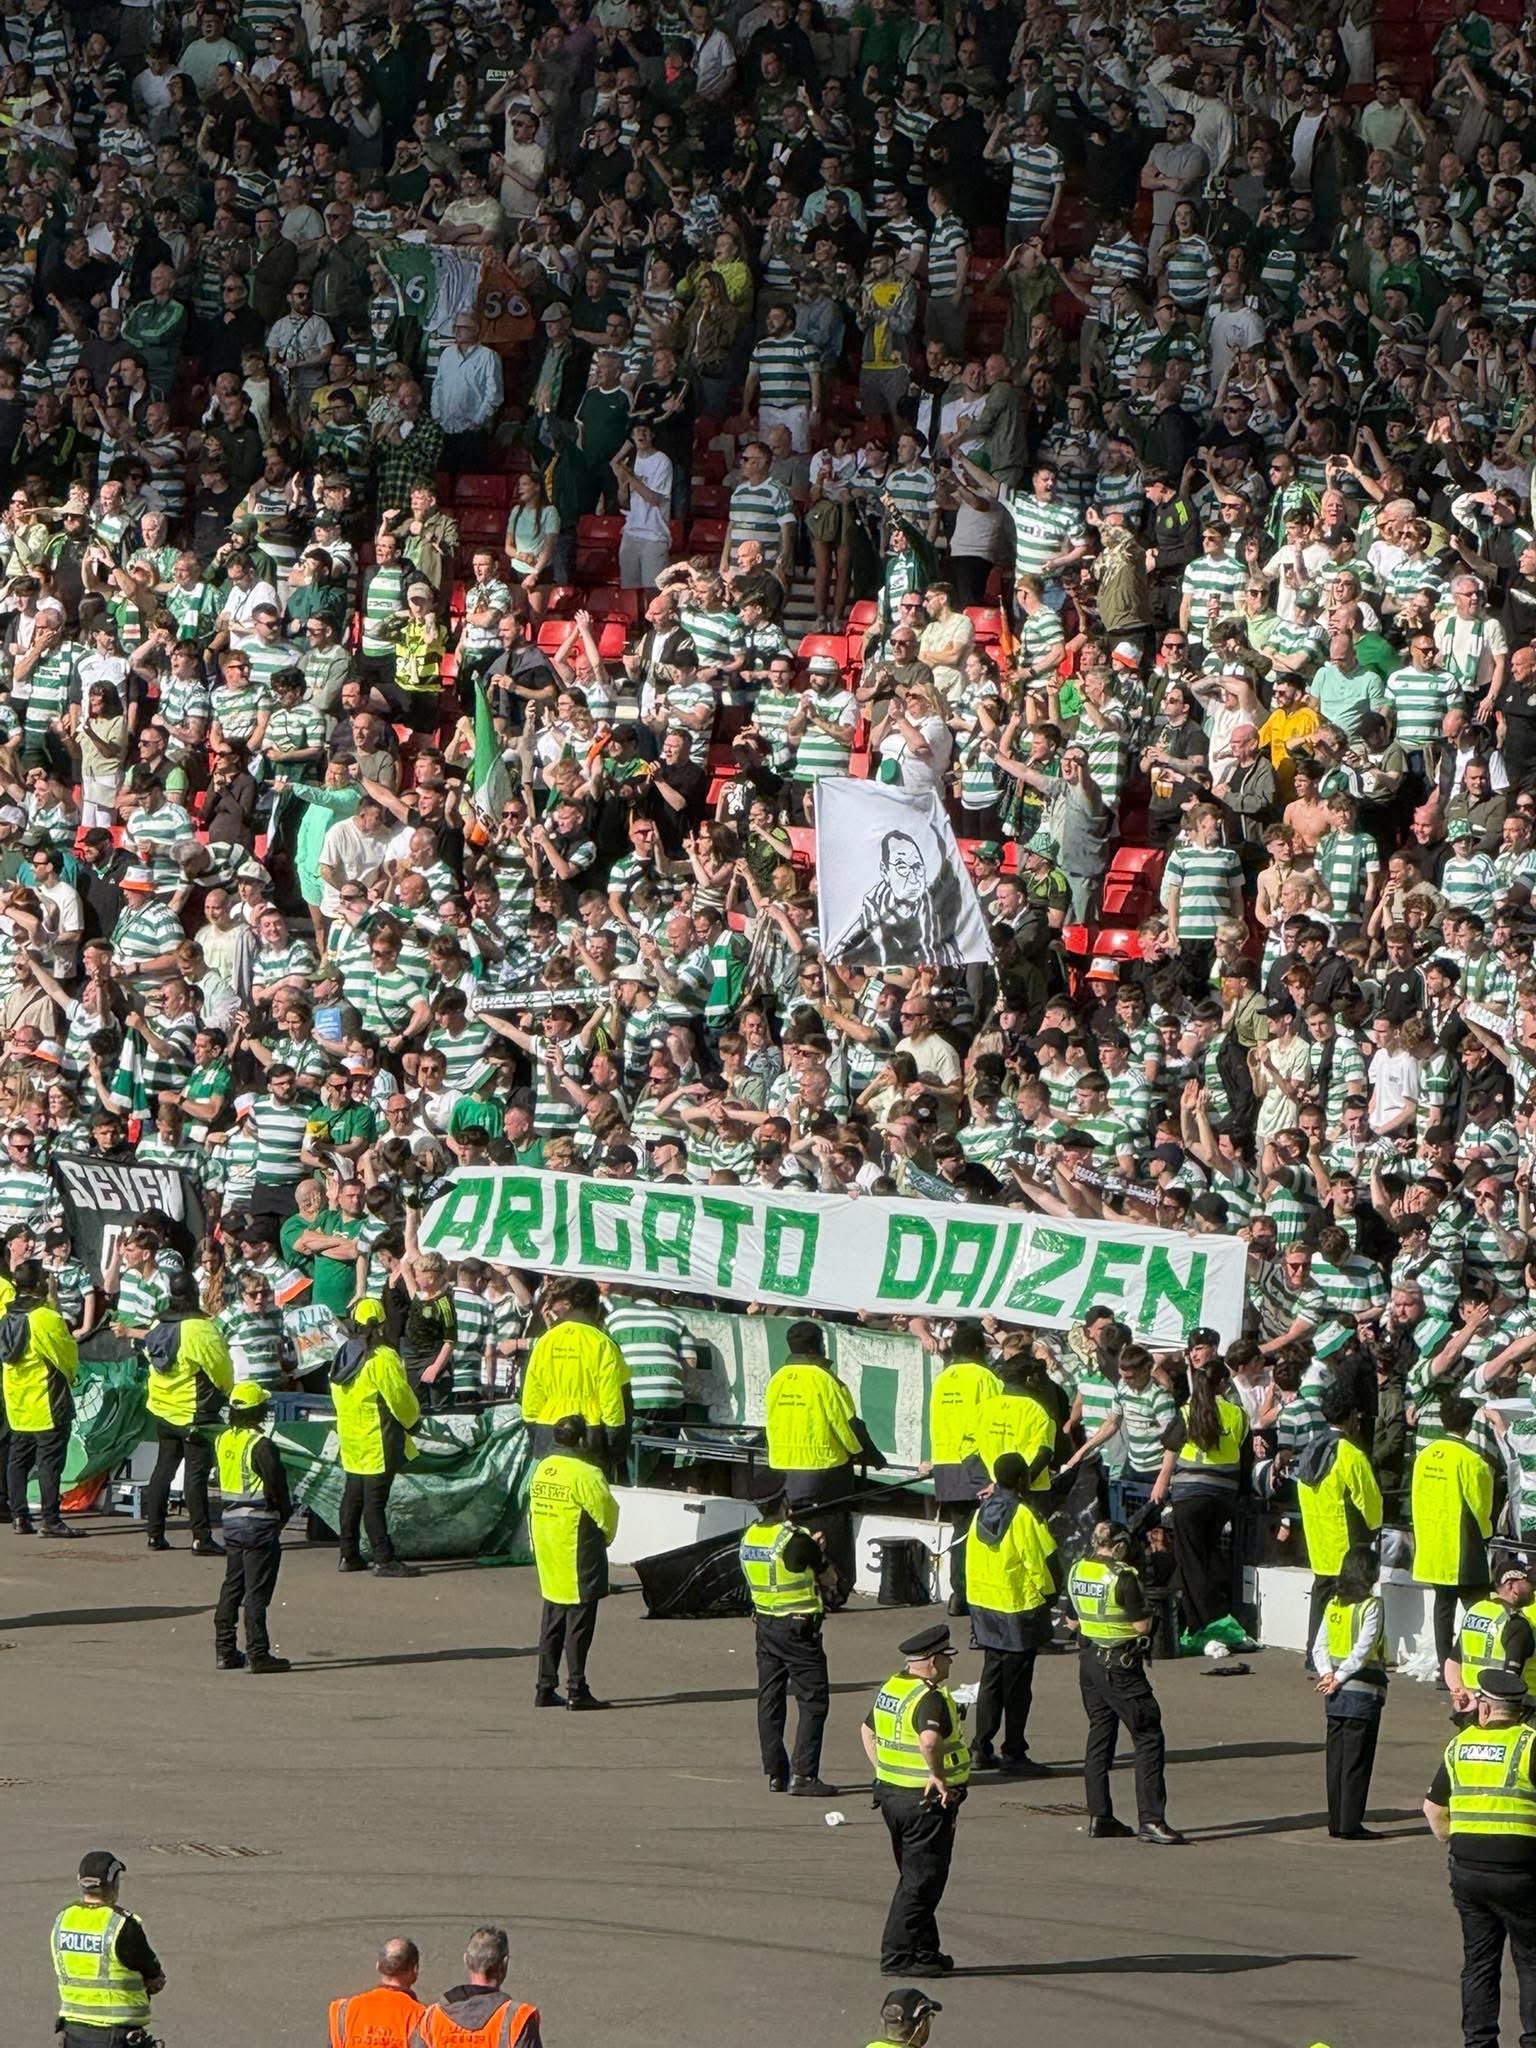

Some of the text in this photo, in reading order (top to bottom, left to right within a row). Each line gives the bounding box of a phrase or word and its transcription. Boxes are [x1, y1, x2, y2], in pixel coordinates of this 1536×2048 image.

[56, 1160, 185, 1221] SEVEN
[423, 1176, 1207, 1341] ARIGATO DAIZEN
[1073, 1582, 1104, 1599] POLICE
[60, 1934, 100, 1952] POLICE
